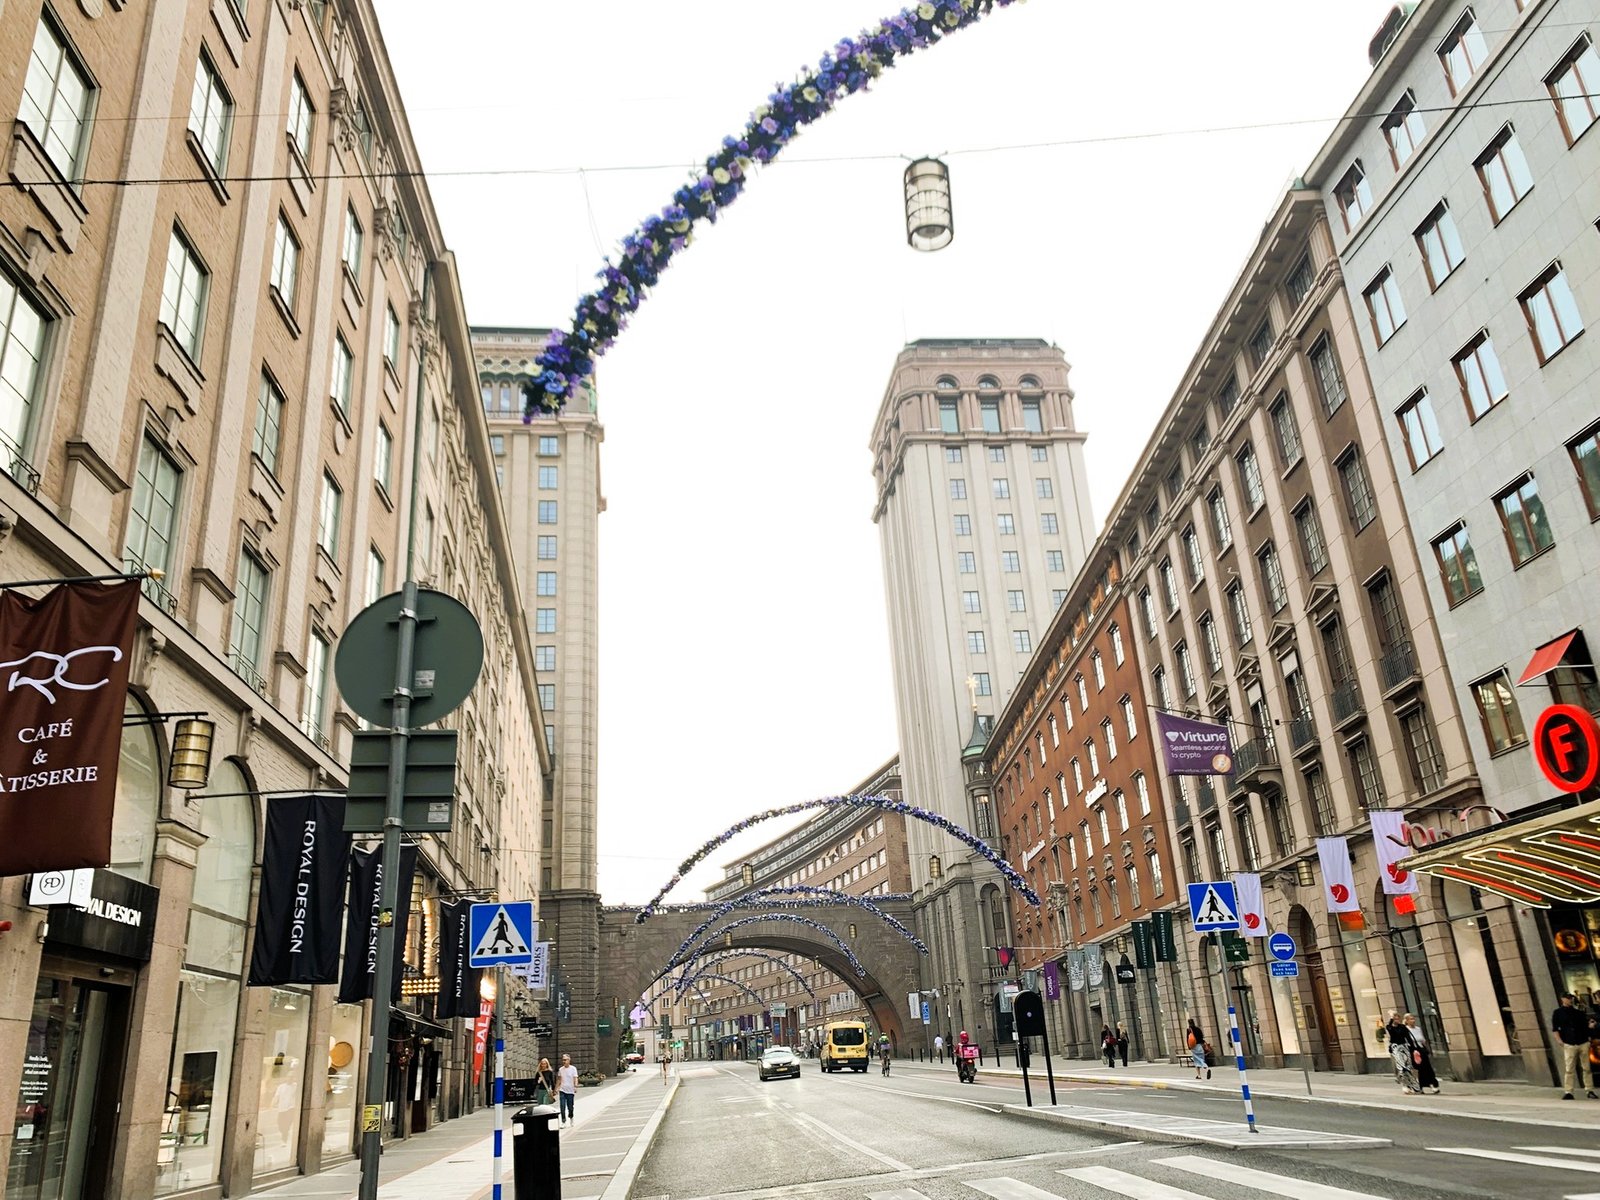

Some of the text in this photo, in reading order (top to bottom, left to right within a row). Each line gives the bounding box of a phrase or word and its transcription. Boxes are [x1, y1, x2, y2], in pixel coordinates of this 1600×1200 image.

[18, 718, 73, 743] CAFÉ
[1180, 731, 1227, 742] Virtune
[32, 748, 48, 765] &
[1179, 752, 1202, 760] crypto
[1548, 723, 1574, 773] F
[289, 820, 316, 953] ROYAL DESIGN
[105, 903, 142, 927] DESIGN
[366, 914, 379, 974] DESIGN
[475, 1002, 491, 1054] SALE
